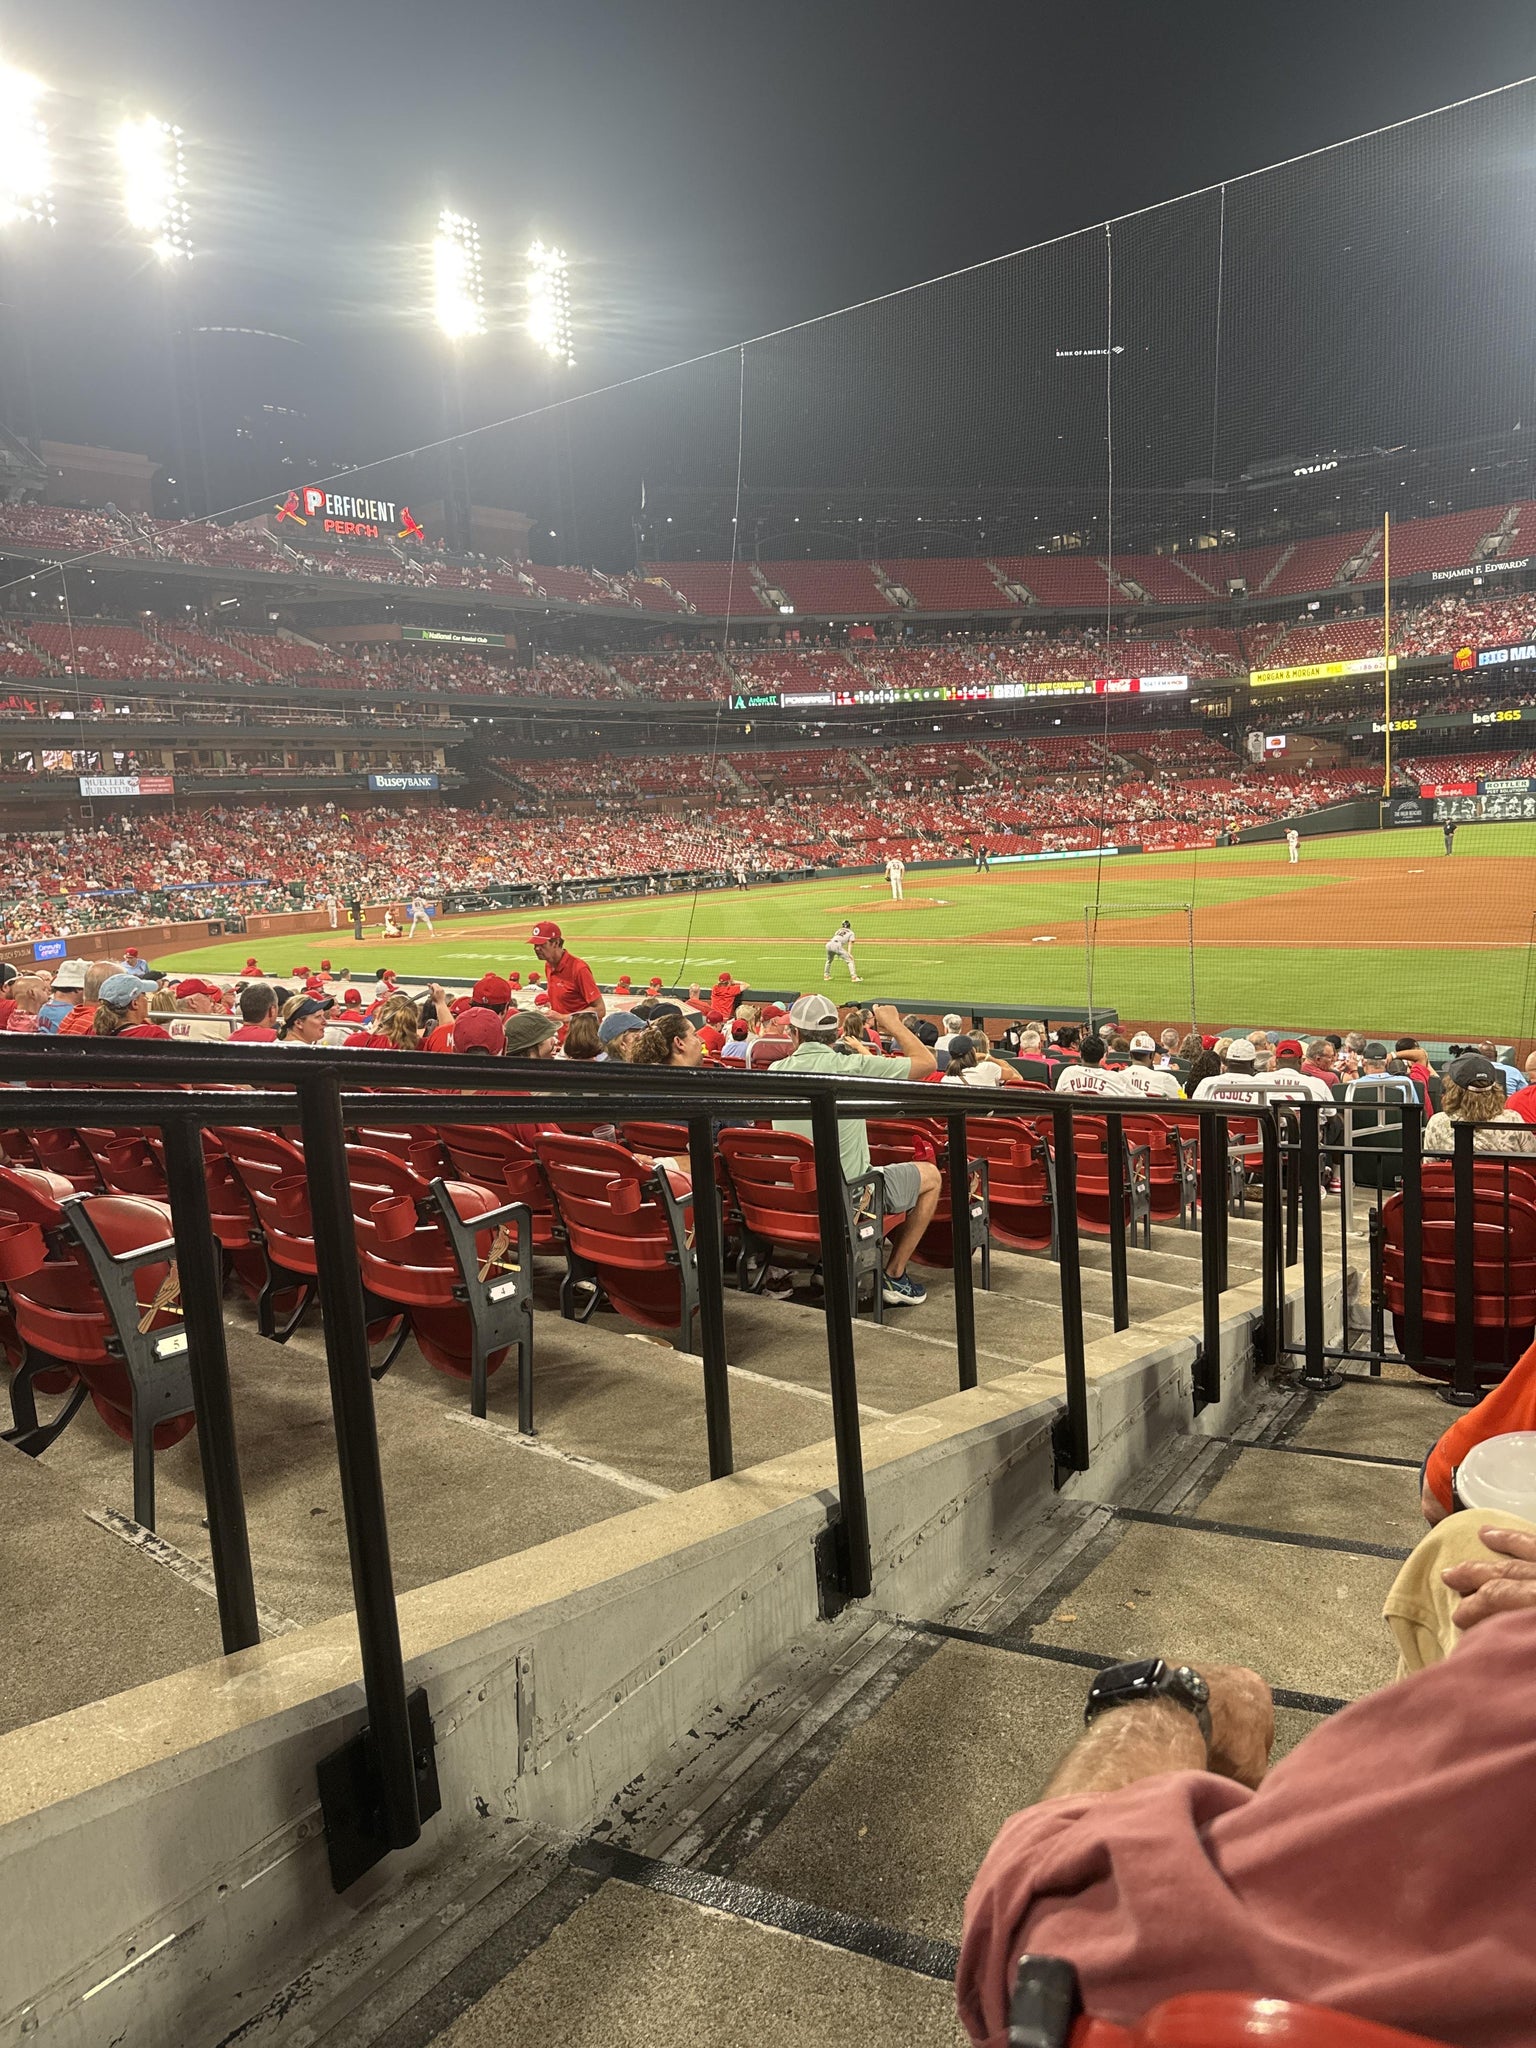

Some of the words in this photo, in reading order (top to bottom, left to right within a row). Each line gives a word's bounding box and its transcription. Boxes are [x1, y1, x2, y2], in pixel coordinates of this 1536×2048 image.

[303, 487, 396, 523] PERFICIENT
[324, 519, 379, 538] PERCH
[1432, 568, 1474, 580] BENJAMIN
[1475, 565, 1482, 574] F.
[1485, 559, 1527, 573] EDWARDS
[429, 631, 452, 640] National
[1257, 671, 1284, 683] MORGAN
[1286, 670, 1290, 678] &
[1292, 667, 1320, 678] MORGAN
[1472, 710, 1522, 724] bet365
[85, 778, 125, 786] MUELLER
[86, 787, 137, 795] FURNITURE
[1070, 1077, 1107, 1092] PUJOLS
